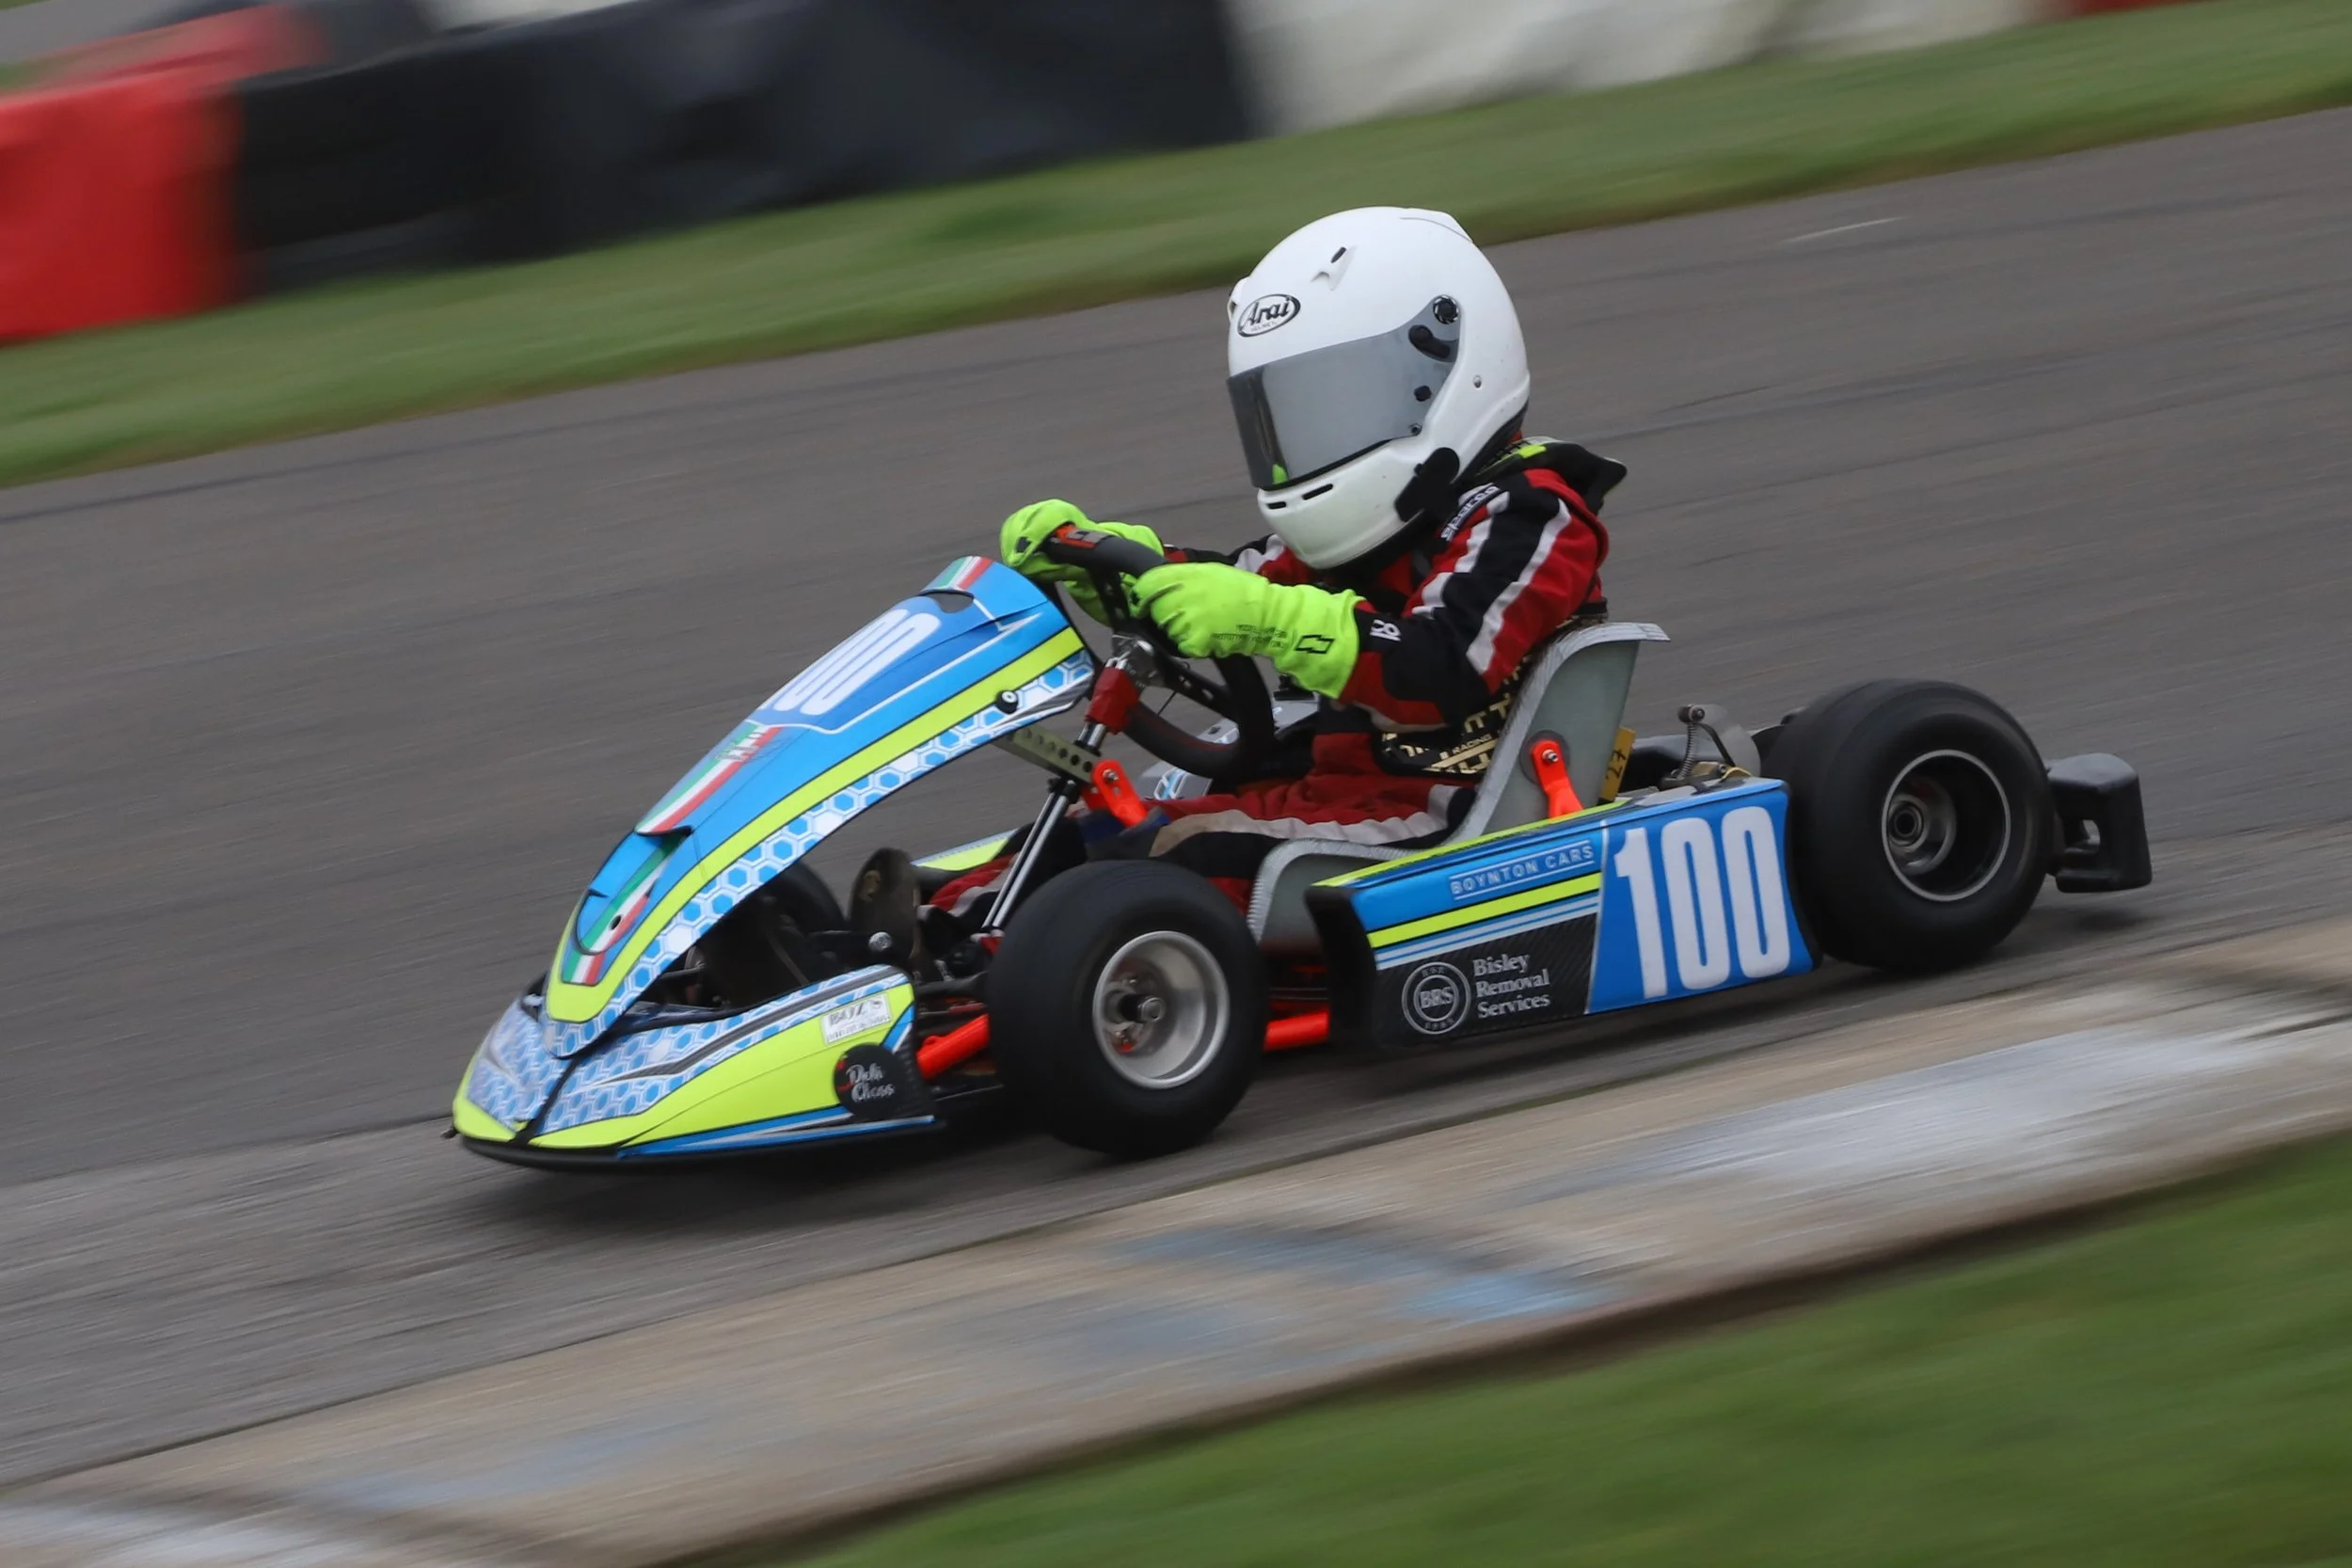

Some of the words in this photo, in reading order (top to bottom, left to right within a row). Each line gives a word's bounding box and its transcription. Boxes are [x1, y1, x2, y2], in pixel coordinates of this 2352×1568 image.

[1239, 296, 1290, 332] Arai
[1450, 860, 1539, 895] BOYNTON
[1545, 845, 1595, 869] CARS
[1613, 806, 1791, 999] 100
[1472, 953, 1530, 976] Bisley
[1419, 986, 1454, 1009] BRS
[1475, 968, 1550, 998] Removal
[1477, 993, 1551, 1019] Services
